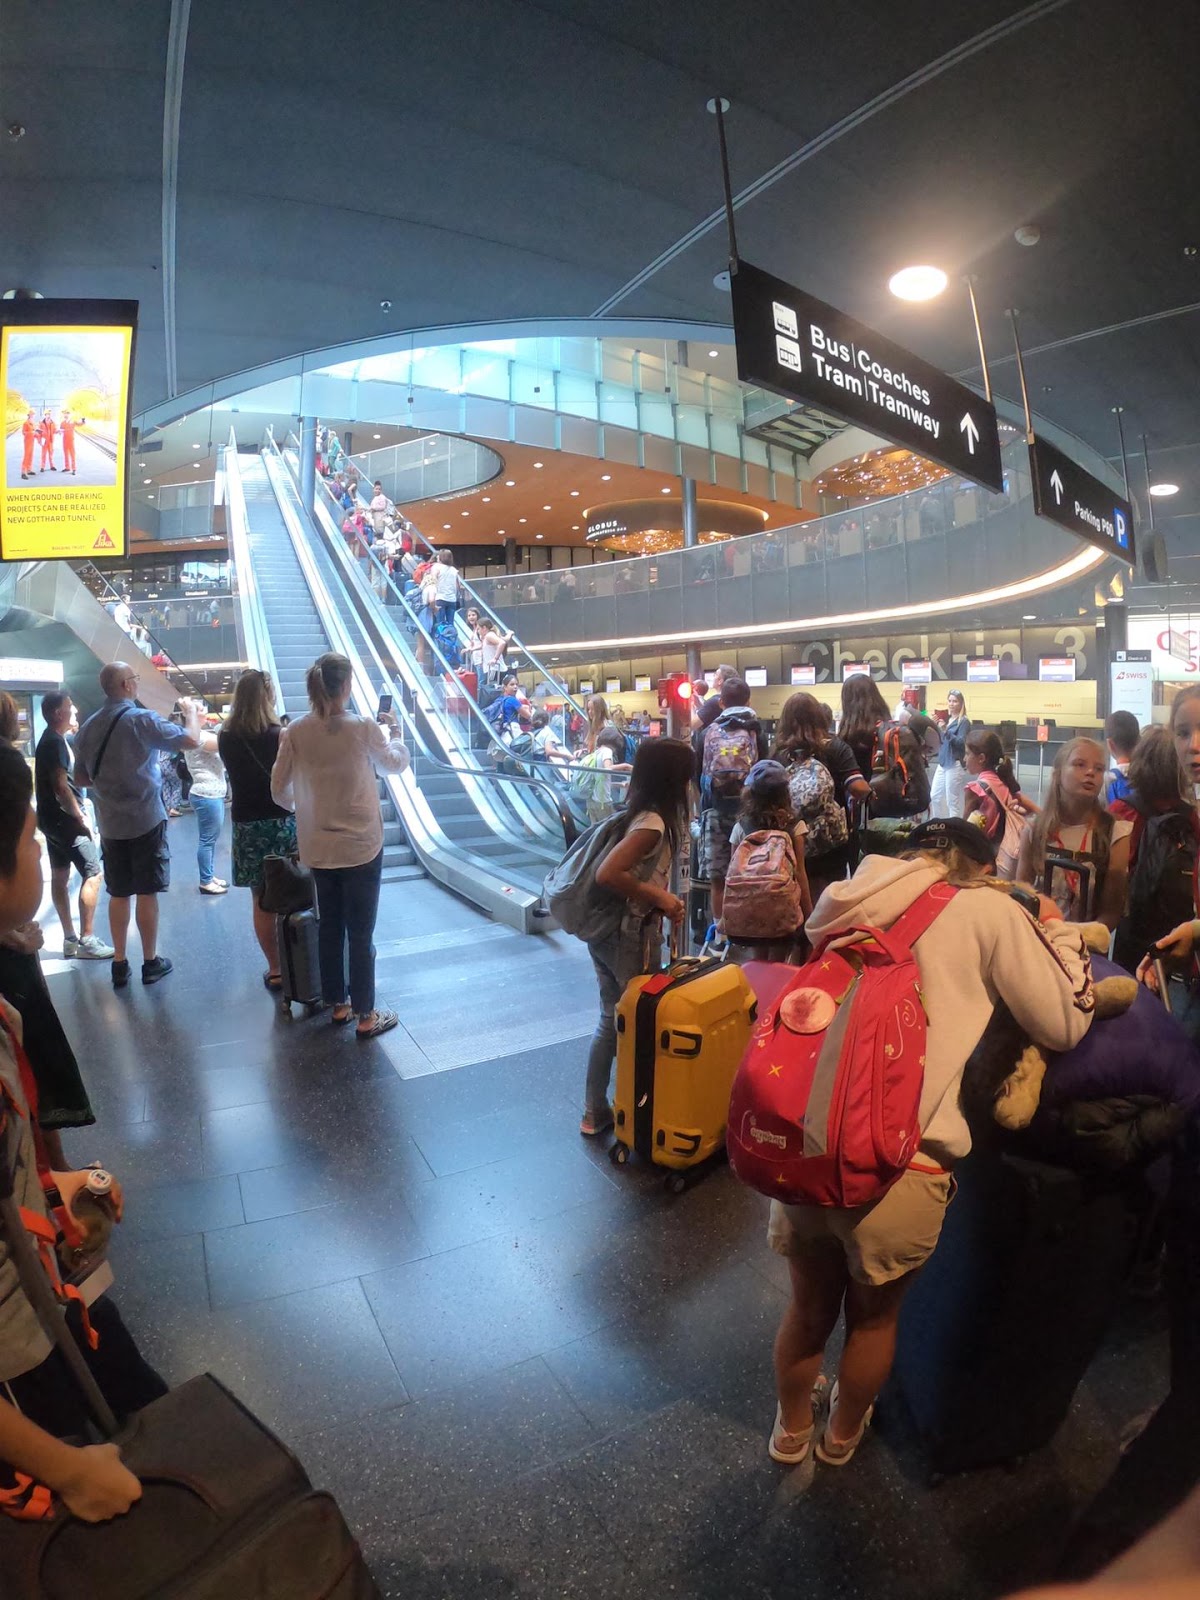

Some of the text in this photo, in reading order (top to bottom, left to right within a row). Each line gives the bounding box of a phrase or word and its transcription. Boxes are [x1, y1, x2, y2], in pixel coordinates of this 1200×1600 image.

[810, 324, 931, 405] Bus Coaches
[812, 353, 940, 439] Tram Tramway
[6, 494, 30, 502] WHEN
[7, 505, 41, 513] PROJECTS
[42, 504, 58, 512] CAN
[70, 503, 106, 511] REALIZED
[7, 514, 96, 524] NEW GOTTHARD TUNNEL
[587, 520, 618, 534] GLOBUS
[1074, 500, 1101, 532] Parking
[1116, 513, 1125, 543] P
[801, 627, 1088, 682] Check-in 3
[926, 823, 946, 832] POLO
